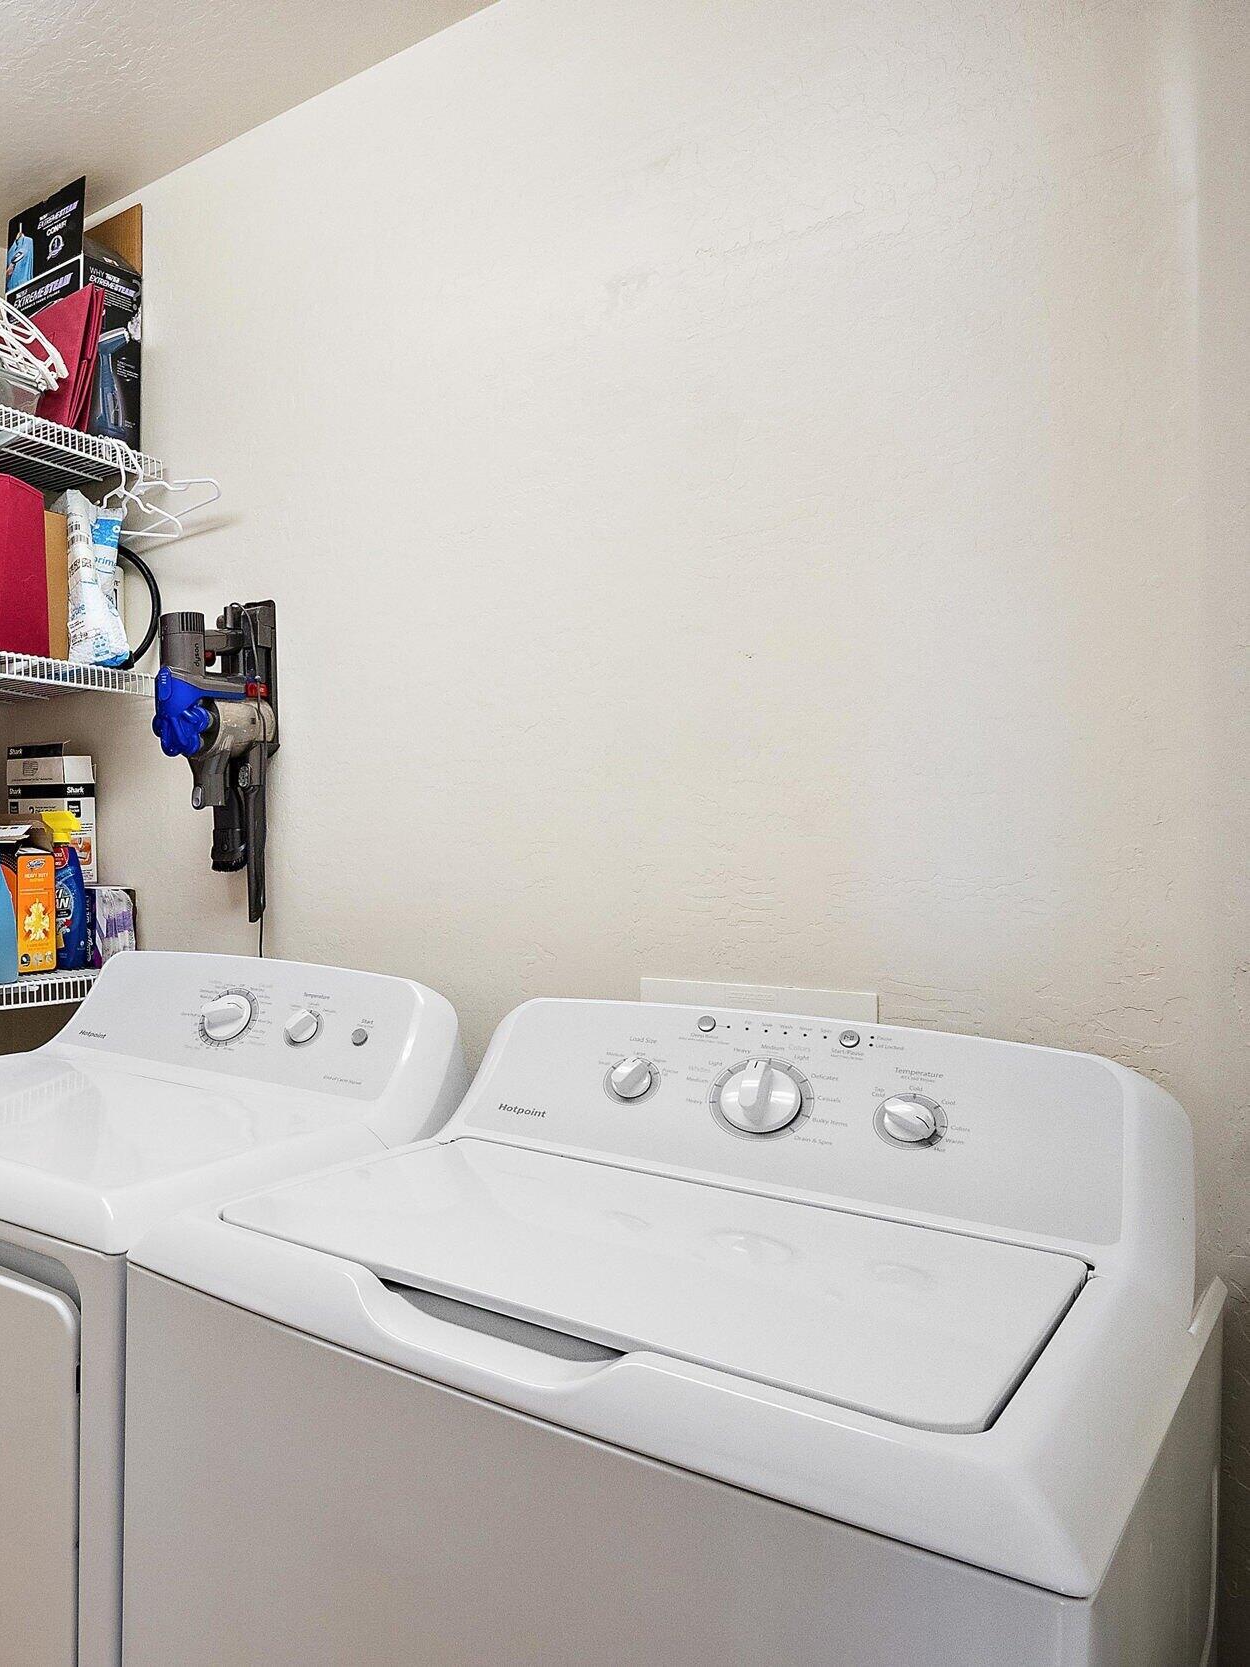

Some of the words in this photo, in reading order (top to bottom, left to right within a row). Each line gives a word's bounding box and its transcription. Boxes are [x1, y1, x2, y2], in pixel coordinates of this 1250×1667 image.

[89, 266, 105, 277] WHY
[9, 748, 23, 756] Shark
[66, 786, 85, 794] Shark
[78, 1029, 107, 1040] Hotpoint
[894, 1067, 944, 1079] Temperature
[497, 1103, 547, 1118] Hotpoint
